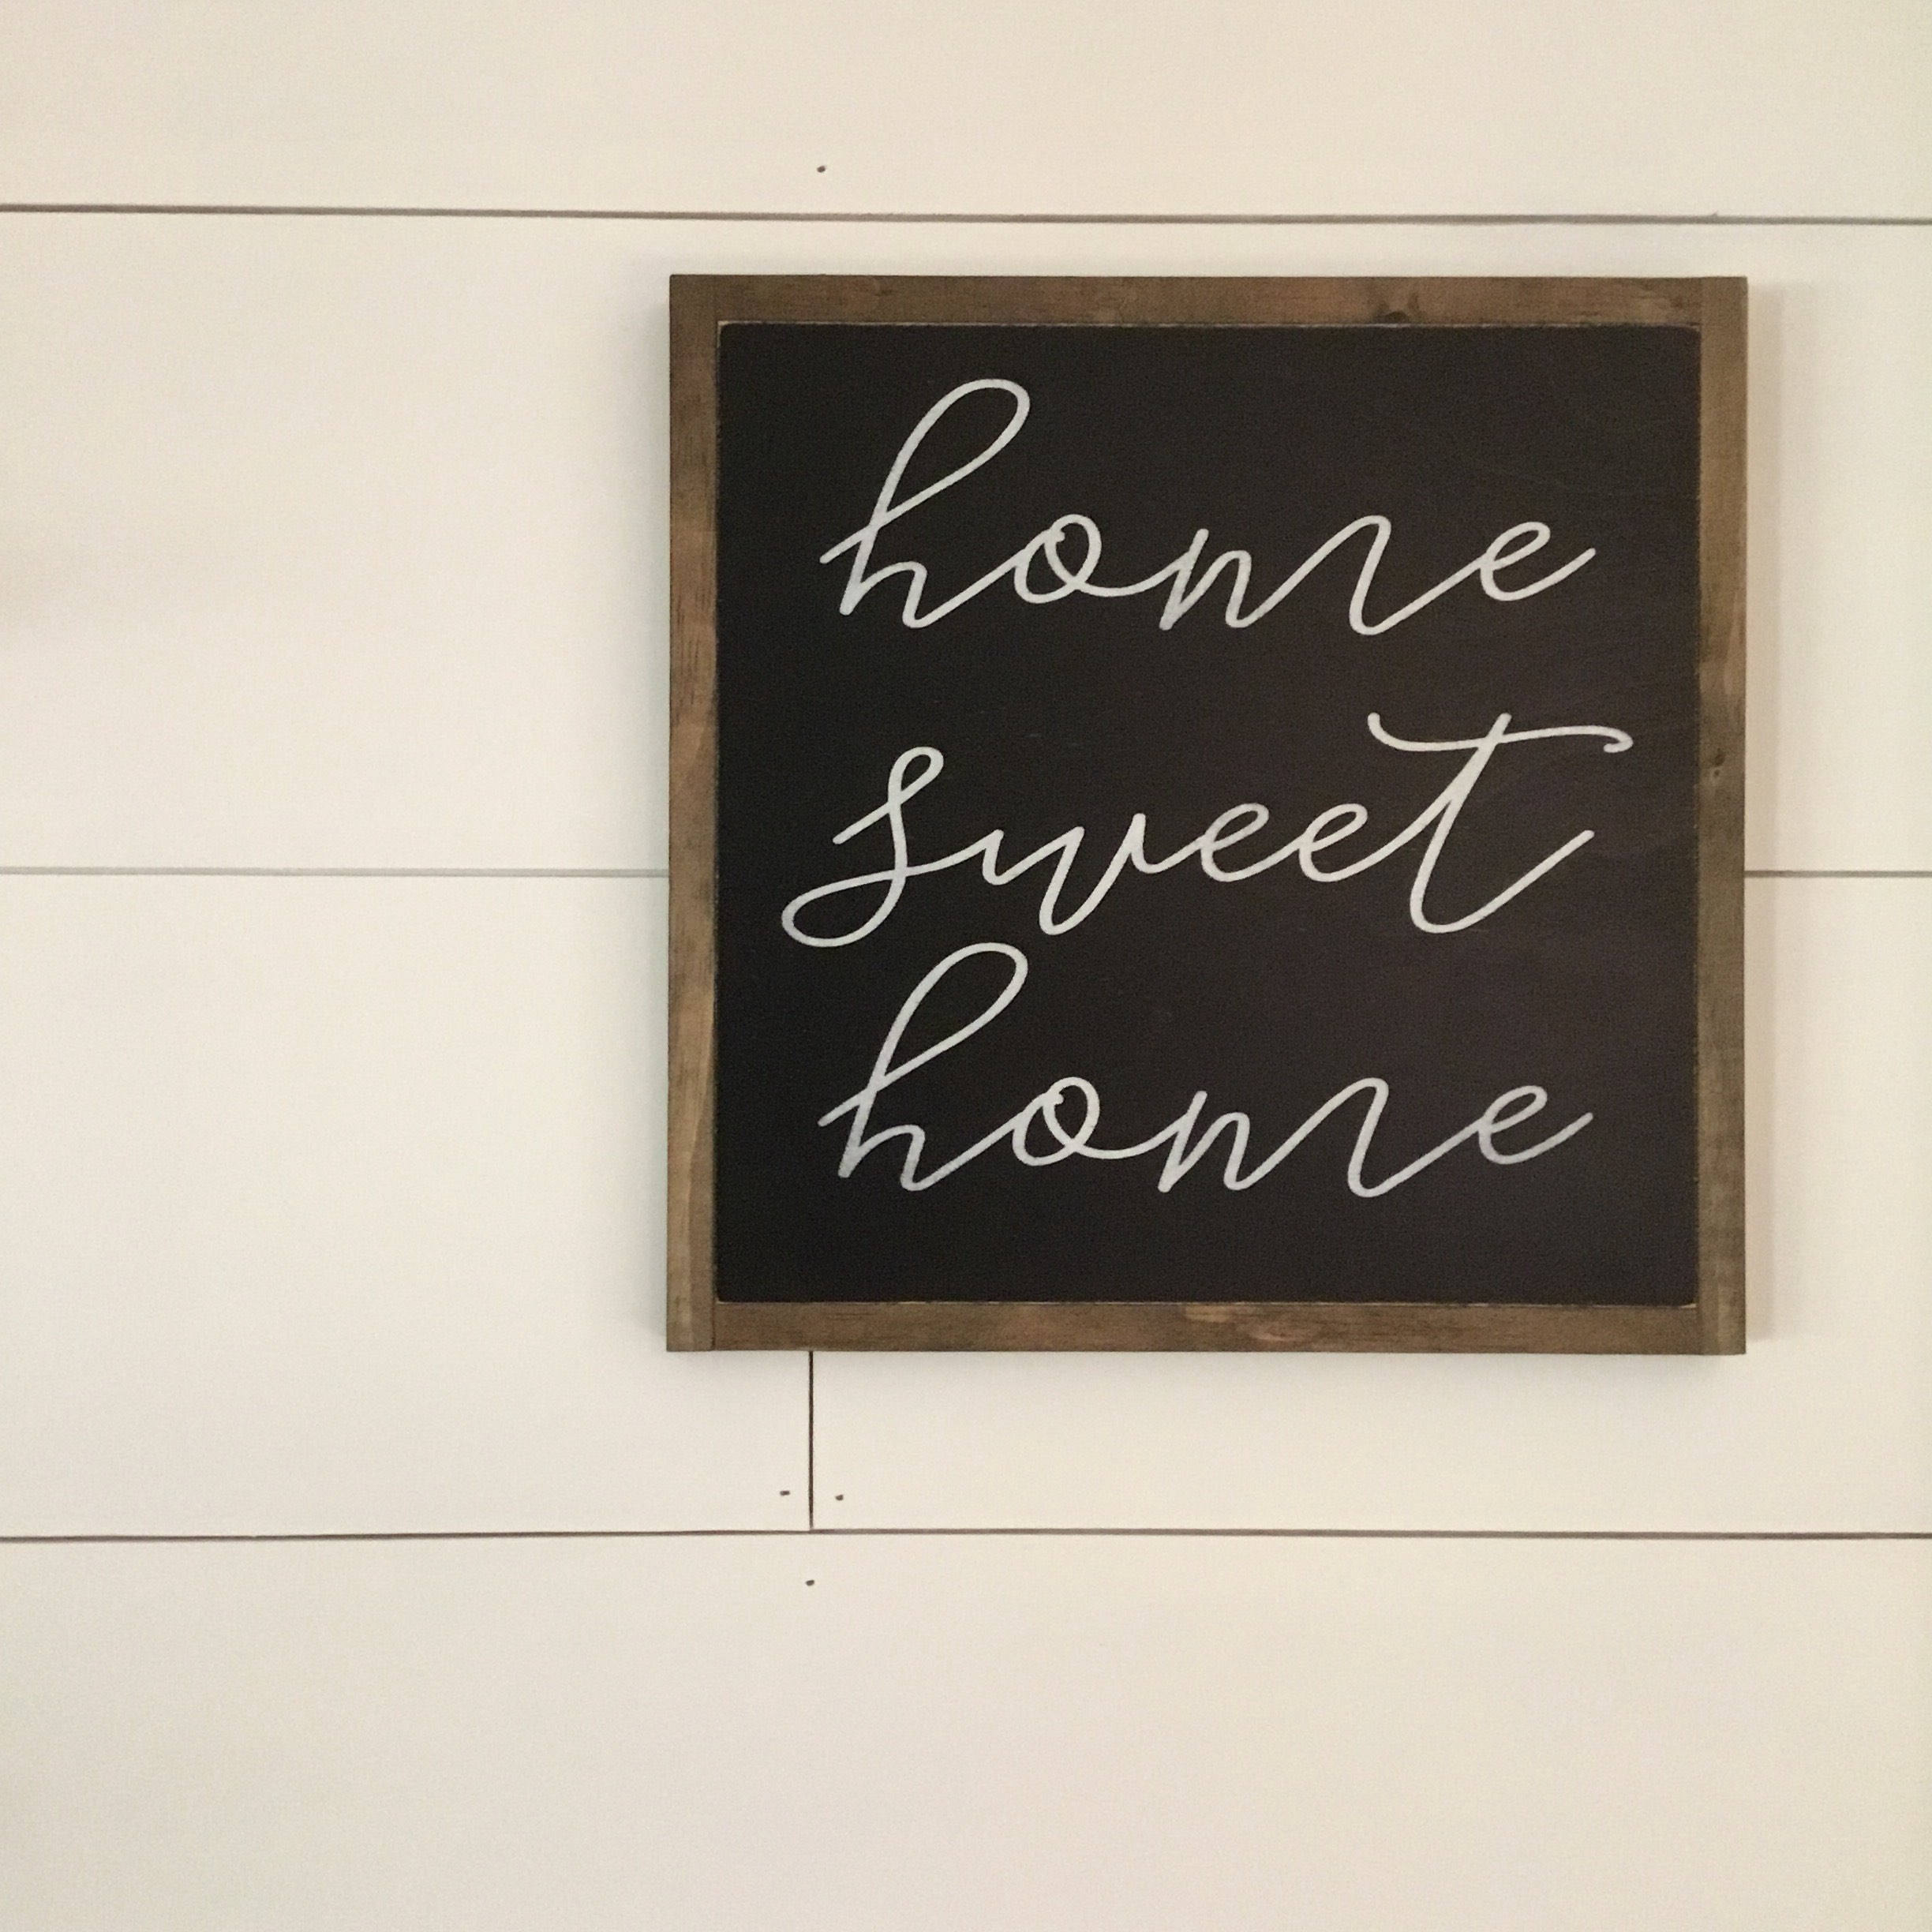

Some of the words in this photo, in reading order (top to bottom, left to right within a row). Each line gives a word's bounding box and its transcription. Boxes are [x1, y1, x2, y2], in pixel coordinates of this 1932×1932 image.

[819, 378, 1596, 635] home
[781, 712, 1634, 948] sweet
[818, 942, 1593, 1198] home
